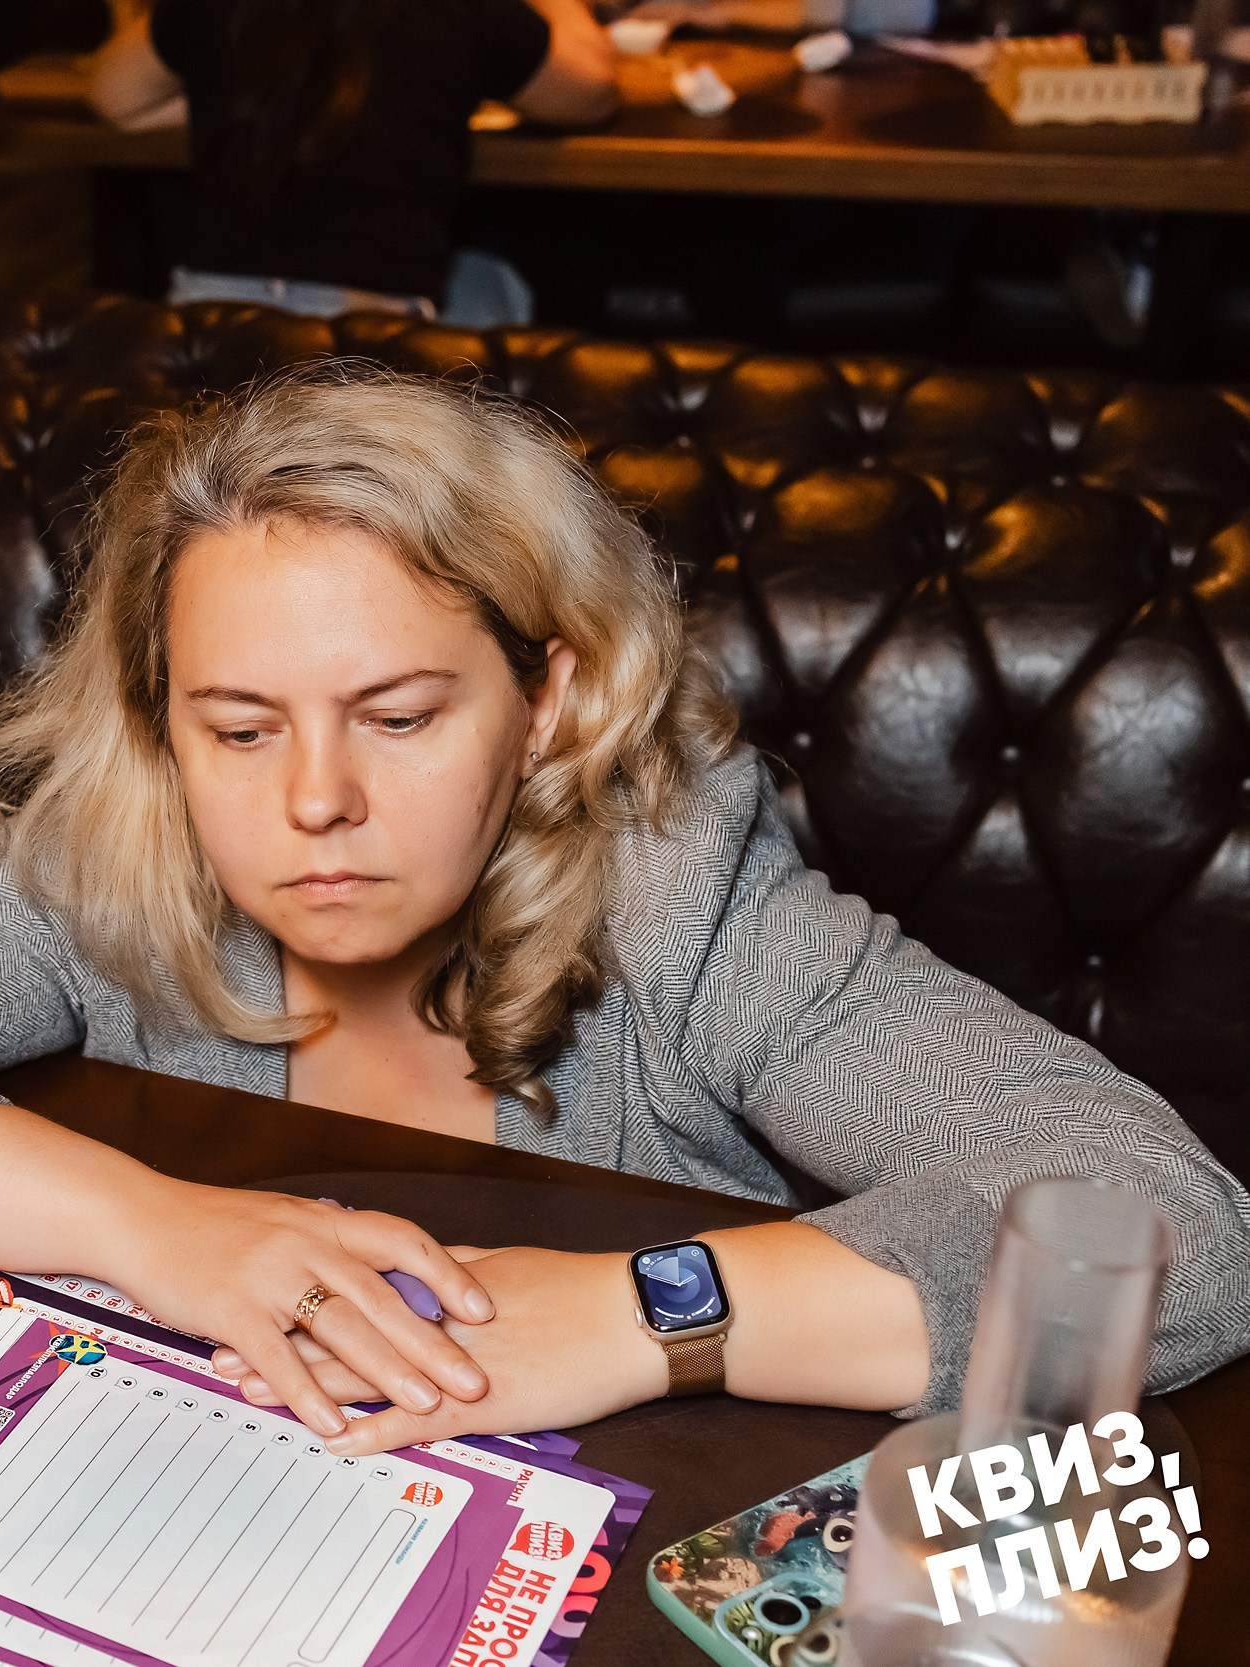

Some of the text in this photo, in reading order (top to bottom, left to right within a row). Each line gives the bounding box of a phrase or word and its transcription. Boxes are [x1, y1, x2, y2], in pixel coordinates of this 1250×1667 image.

[66, 1281, 78, 1291] 17
[87, 1289, 100, 1299] 16
[108, 1297, 121, 1307] 15
[129, 1305, 143, 1315] 14
[91, 1368, 105, 1378] 10
[122, 1379, 133, 1387] 9
[183, 1400, 194, 1408] 7
[213, 1411, 224, 1419] 6
[245, 1423, 257, 1431] 5
[278, 1435, 289, 1443] 4
[309, 1446, 321, 1454] 3
[343, 1458, 355, 1466] 2
[528, 1520, 547, 1562] ПЛИЗ!
[517, 1569, 557, 1605] НЕ
[448, 1558, 526, 1667] ДЛЯ ЗАП
